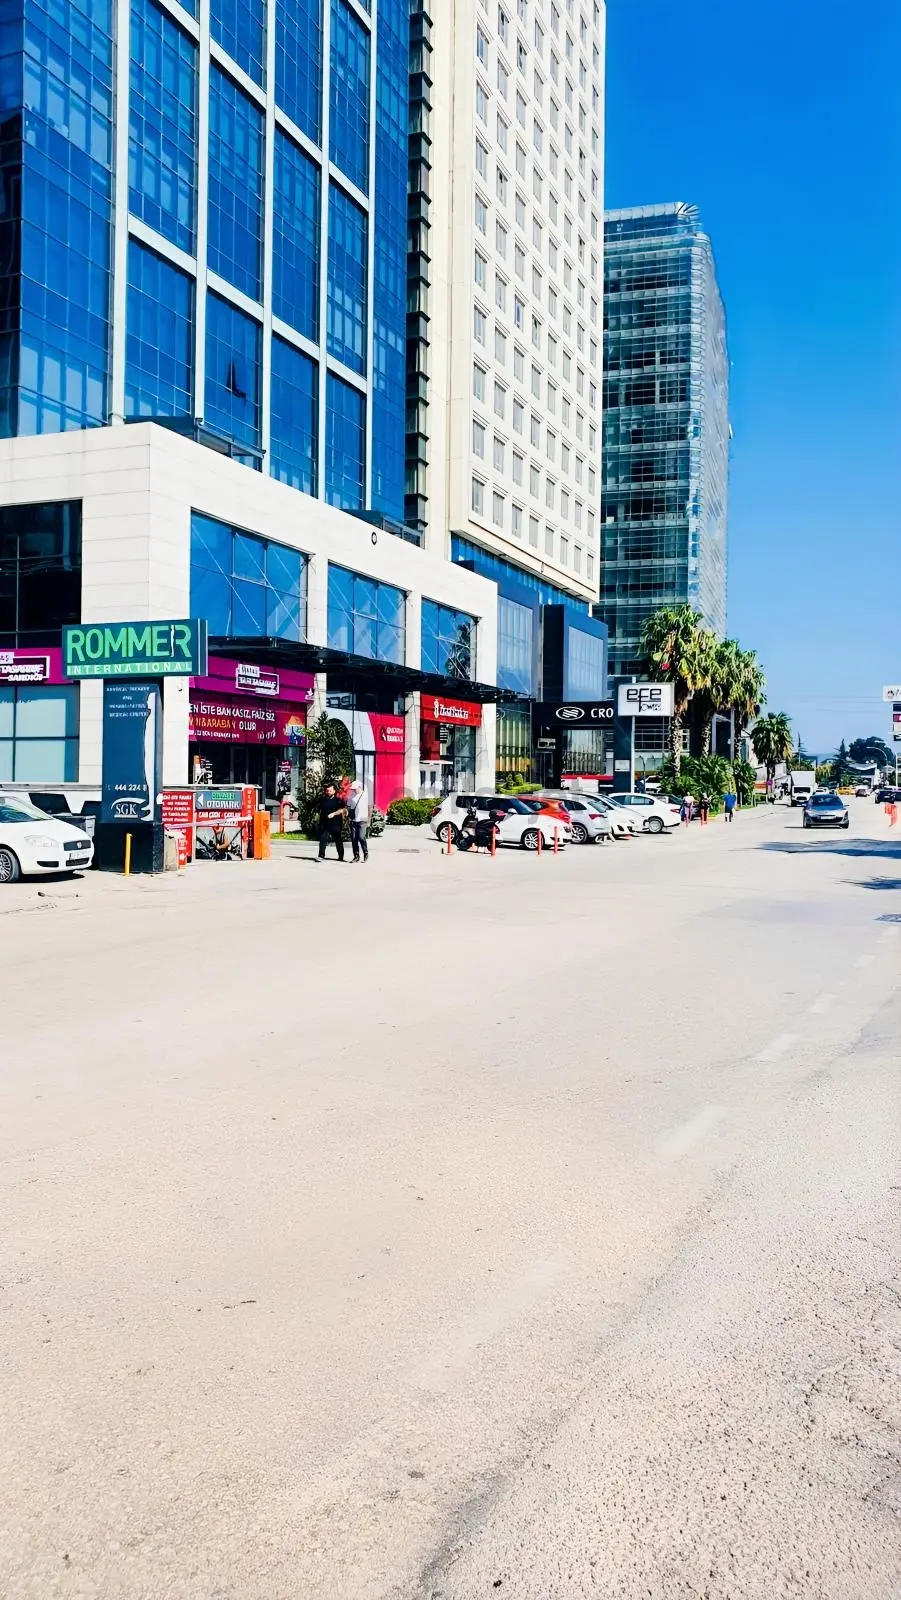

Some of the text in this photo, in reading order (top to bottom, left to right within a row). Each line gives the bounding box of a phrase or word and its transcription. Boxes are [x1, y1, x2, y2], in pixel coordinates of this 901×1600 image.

[67, 624, 192, 663] ROMMER
[67, 662, 192, 675] INTERNATIONAL
[200, 702, 216, 715] İSTE
[590, 708, 614, 718] CRO
[238, 720, 257, 731] OLUR
[114, 783, 127, 791] 444
[115, 803, 137, 815] SGK
[206, 800, 240, 809] OTOPARK
